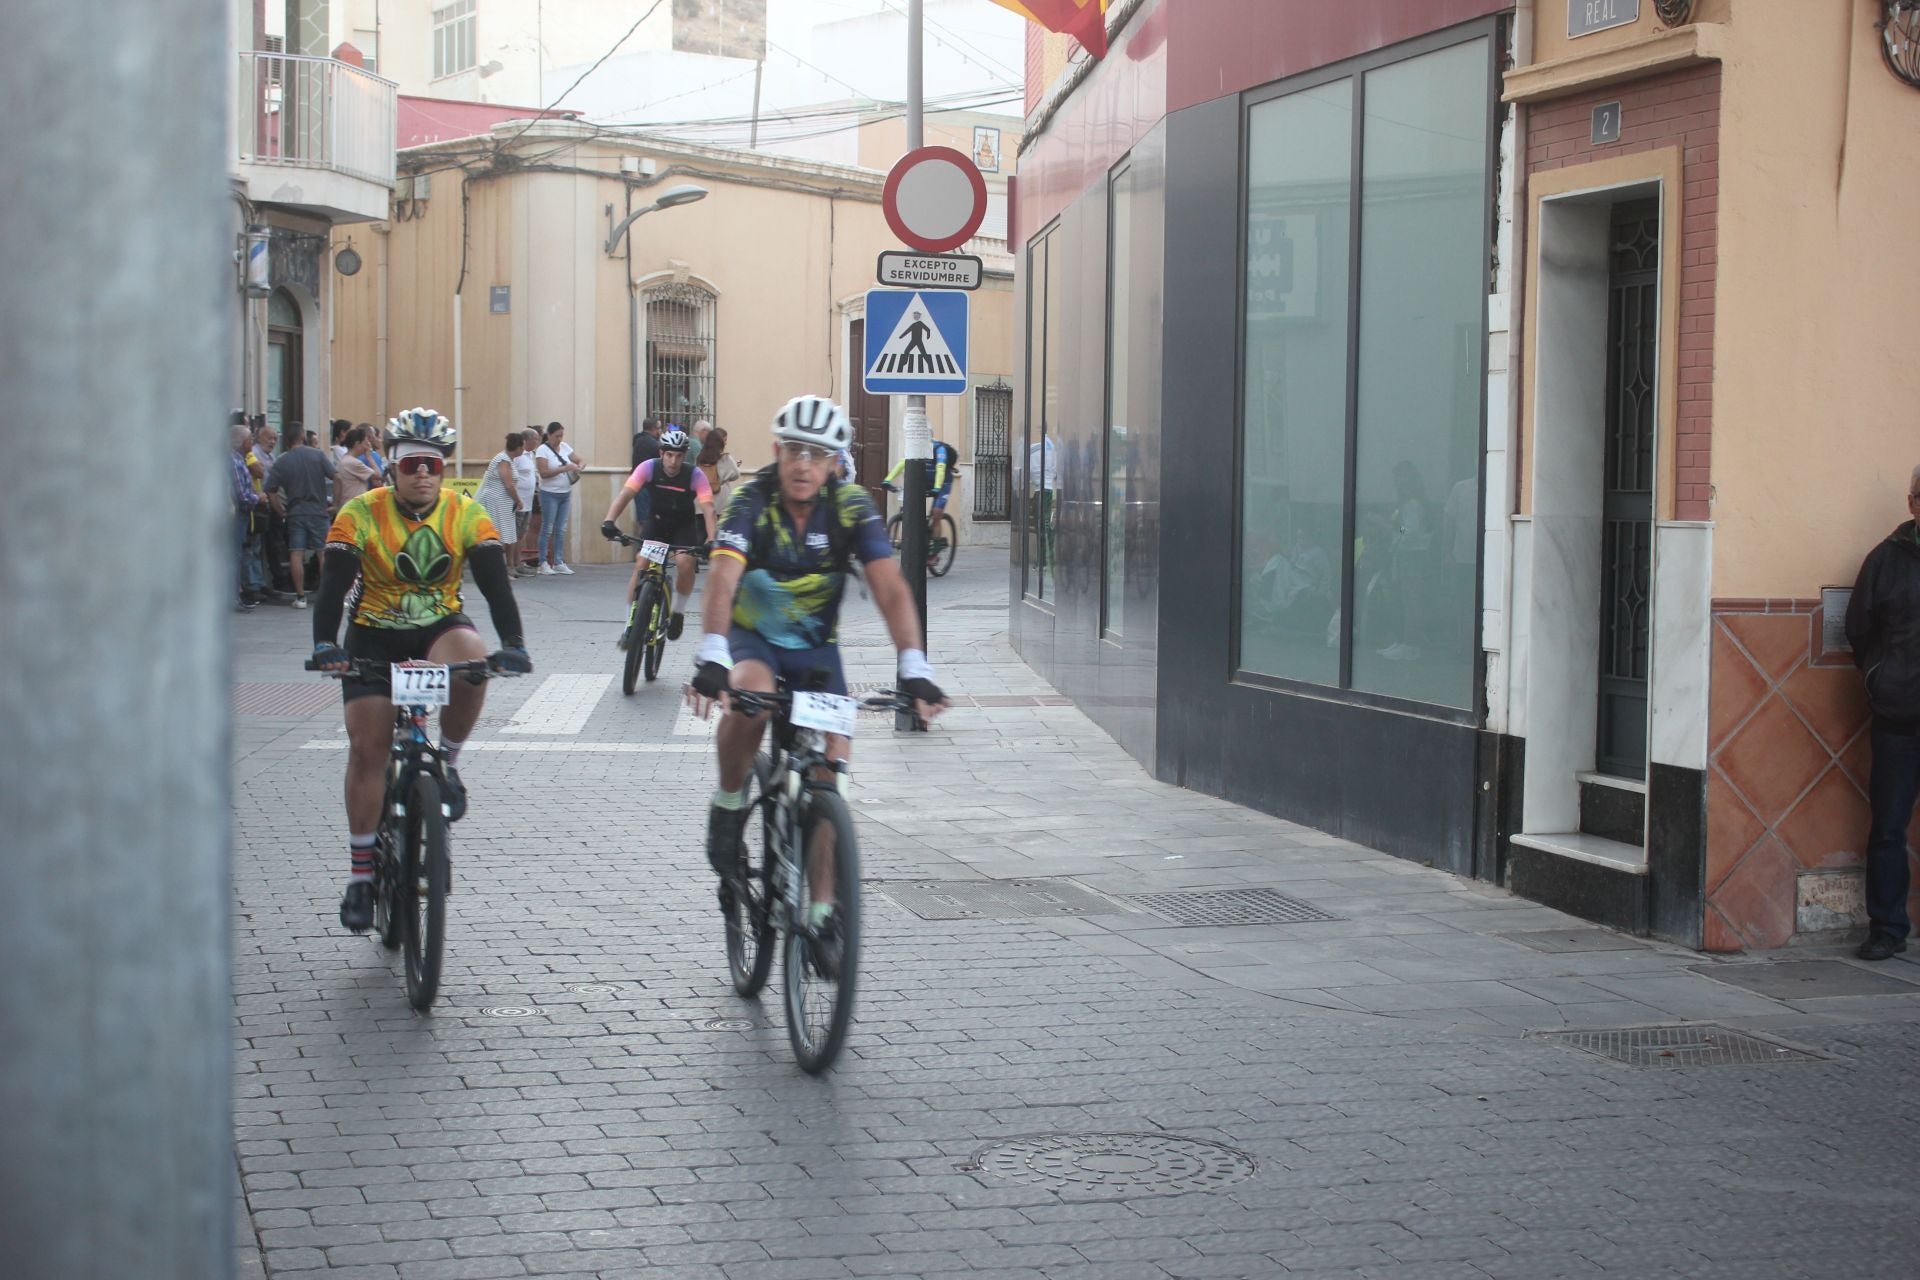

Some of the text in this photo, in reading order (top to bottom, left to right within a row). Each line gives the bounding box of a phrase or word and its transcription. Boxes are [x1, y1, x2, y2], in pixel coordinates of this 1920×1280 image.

[1585, 0, 1616, 25] REAL
[1602, 111, 1610, 135] 2
[904, 259, 957, 271] EXCEPTO
[890, 269, 970, 283] SERVIDUMBRE
[403, 670, 446, 690] 7722
